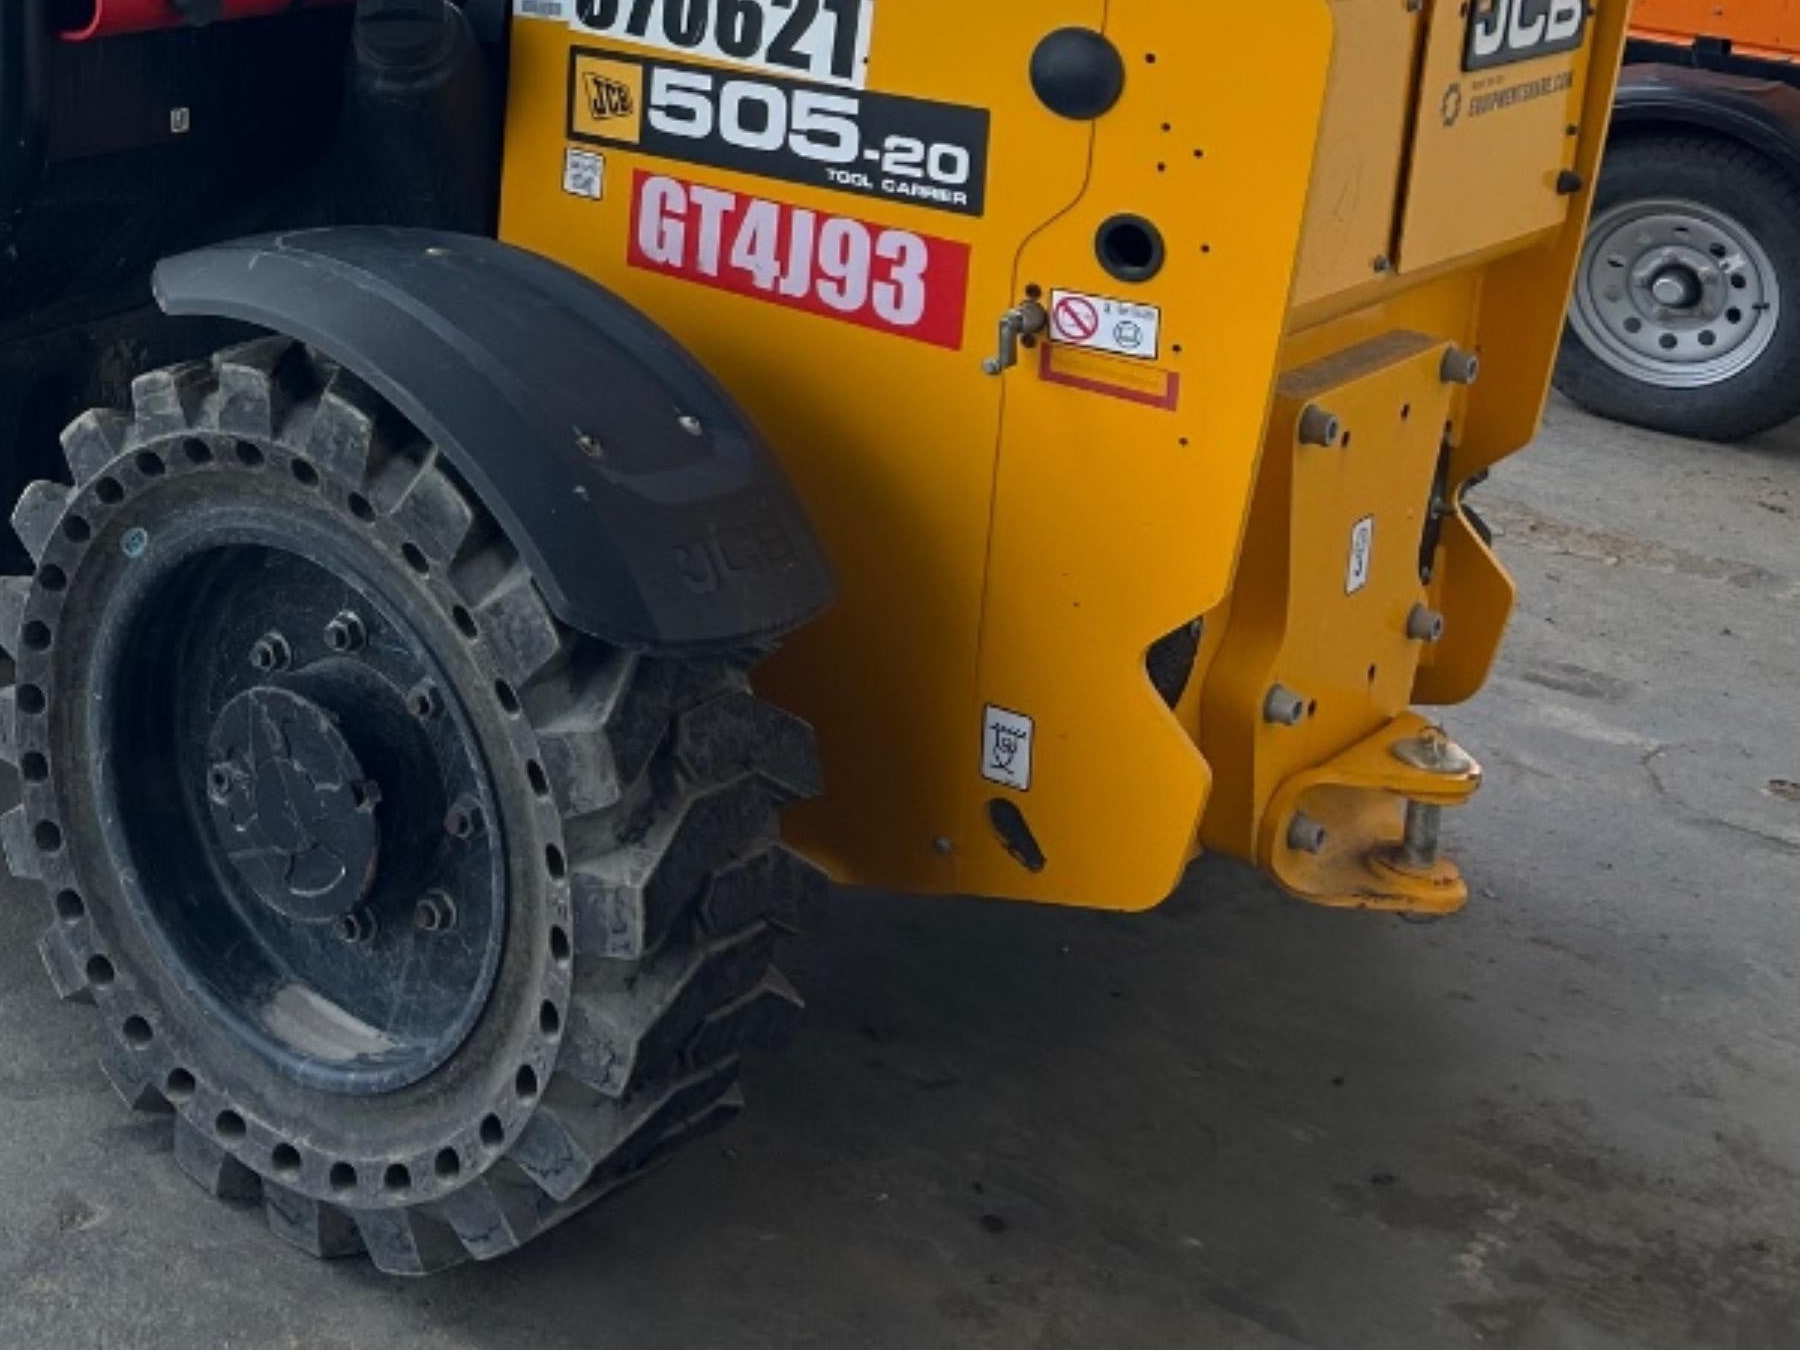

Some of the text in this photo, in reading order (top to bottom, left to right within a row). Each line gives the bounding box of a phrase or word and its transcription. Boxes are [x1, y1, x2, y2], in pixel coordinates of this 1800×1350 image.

[582, 71, 634, 120] JCB
[647, 67, 970, 185] 505-20
[826, 168, 874, 190] TOOL
[637, 176, 929, 327] GT4J93
